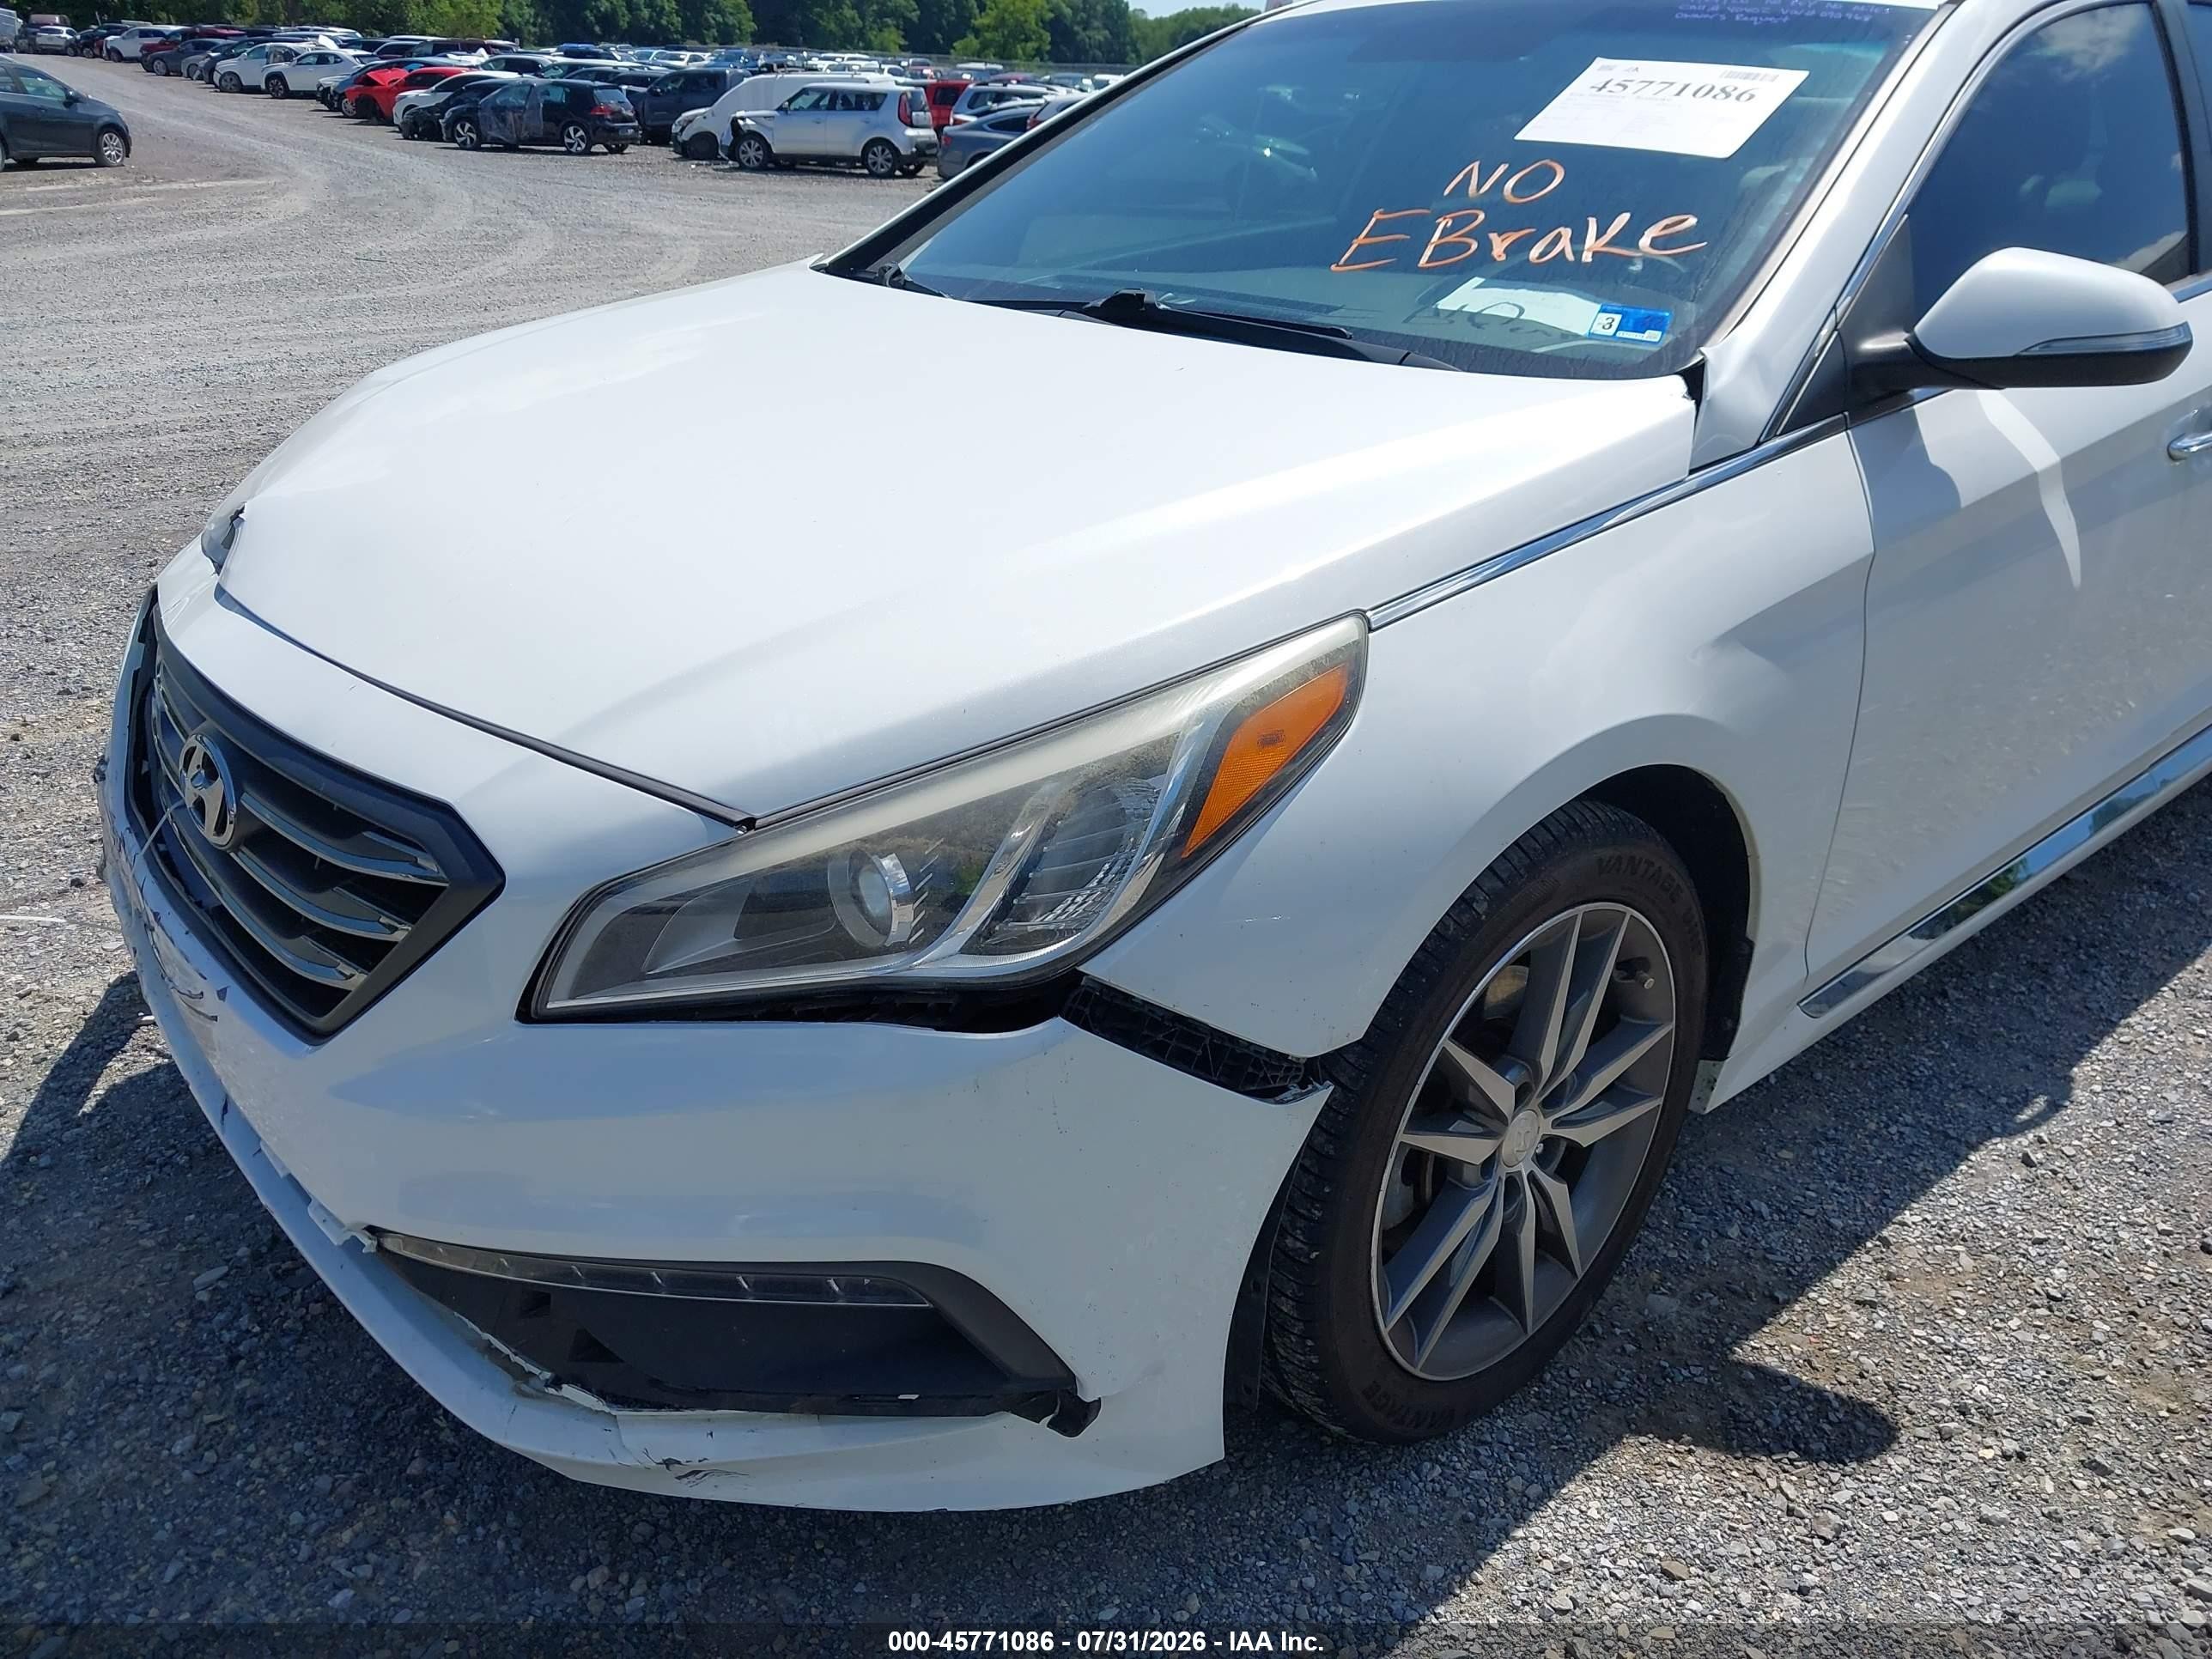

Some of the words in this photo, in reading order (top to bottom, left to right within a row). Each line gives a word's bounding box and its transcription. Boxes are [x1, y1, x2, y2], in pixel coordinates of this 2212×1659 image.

[1589, 78, 1758, 103] 45771086
[1443, 159, 1565, 204] NO
[1601, 316, 1615, 330] 3
